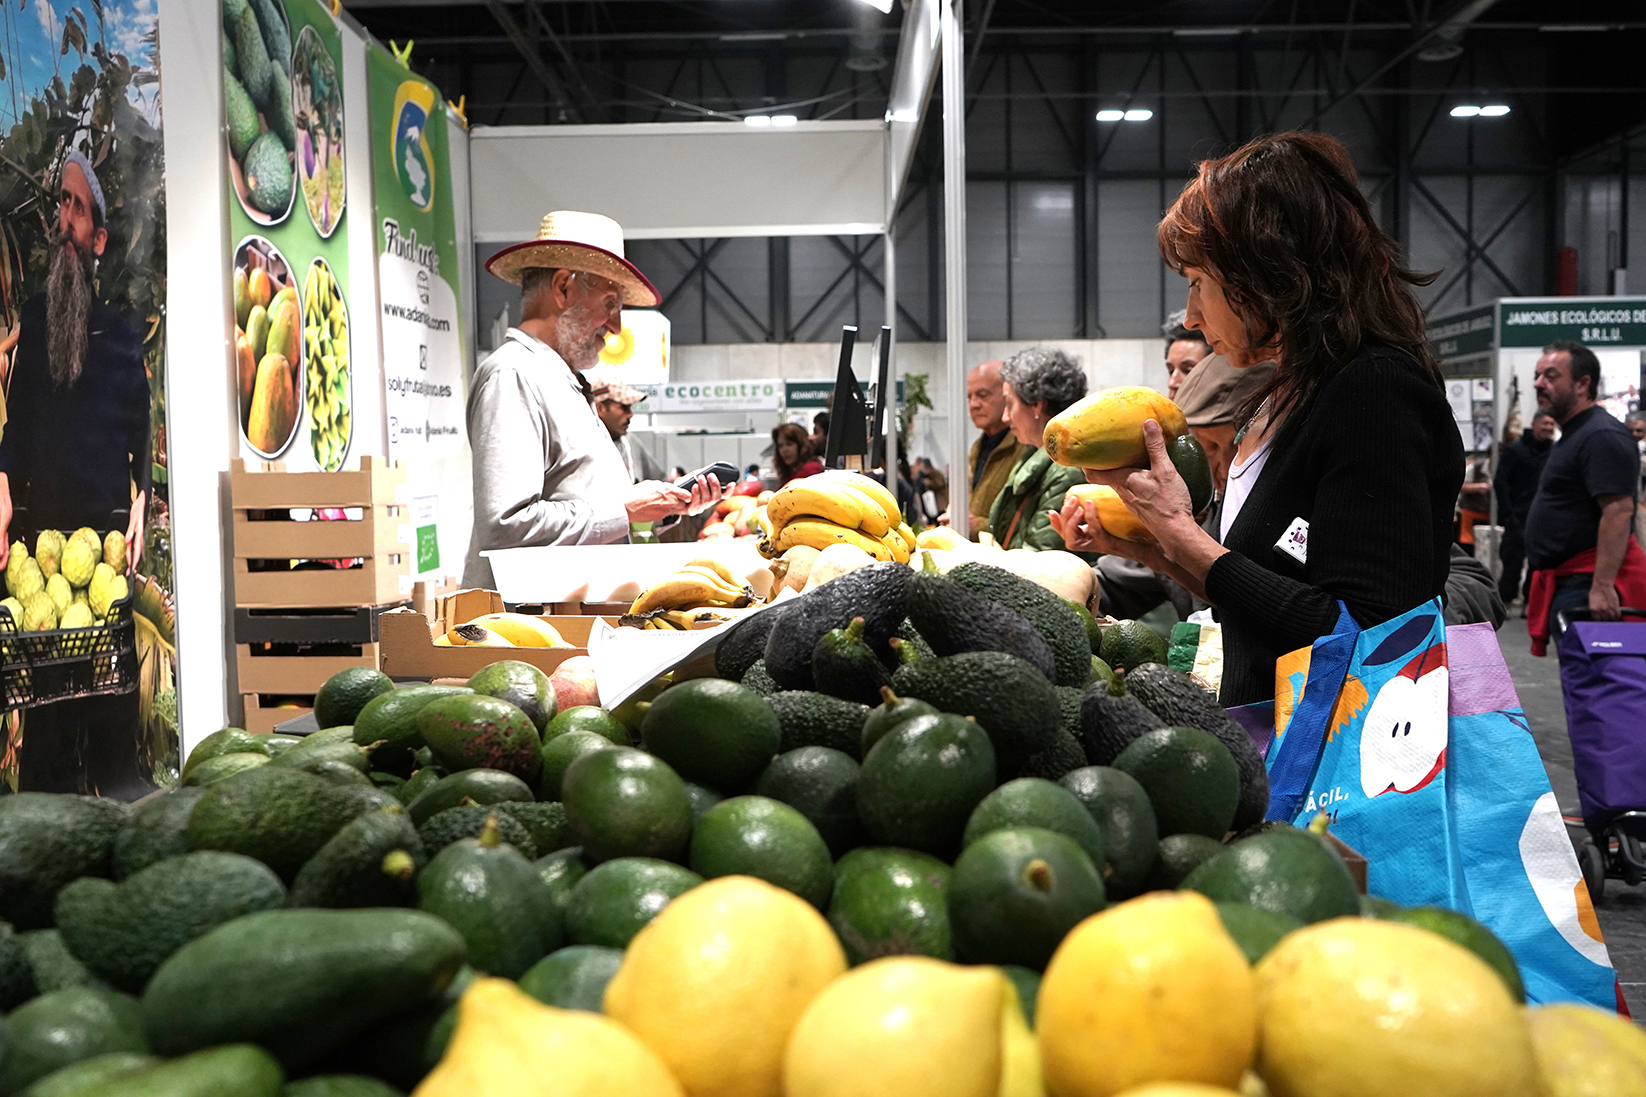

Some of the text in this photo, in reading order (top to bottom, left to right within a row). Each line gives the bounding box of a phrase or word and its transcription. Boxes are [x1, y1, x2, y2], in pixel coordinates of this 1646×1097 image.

[384, 220, 416, 263] Find
[1506, 311, 1559, 325] JAMONES
[1560, 307, 1631, 324] ECOLÓGICOS
[1581, 327, 1623, 342] S.R.L.U.
[665, 383, 774, 399] ecocentro
